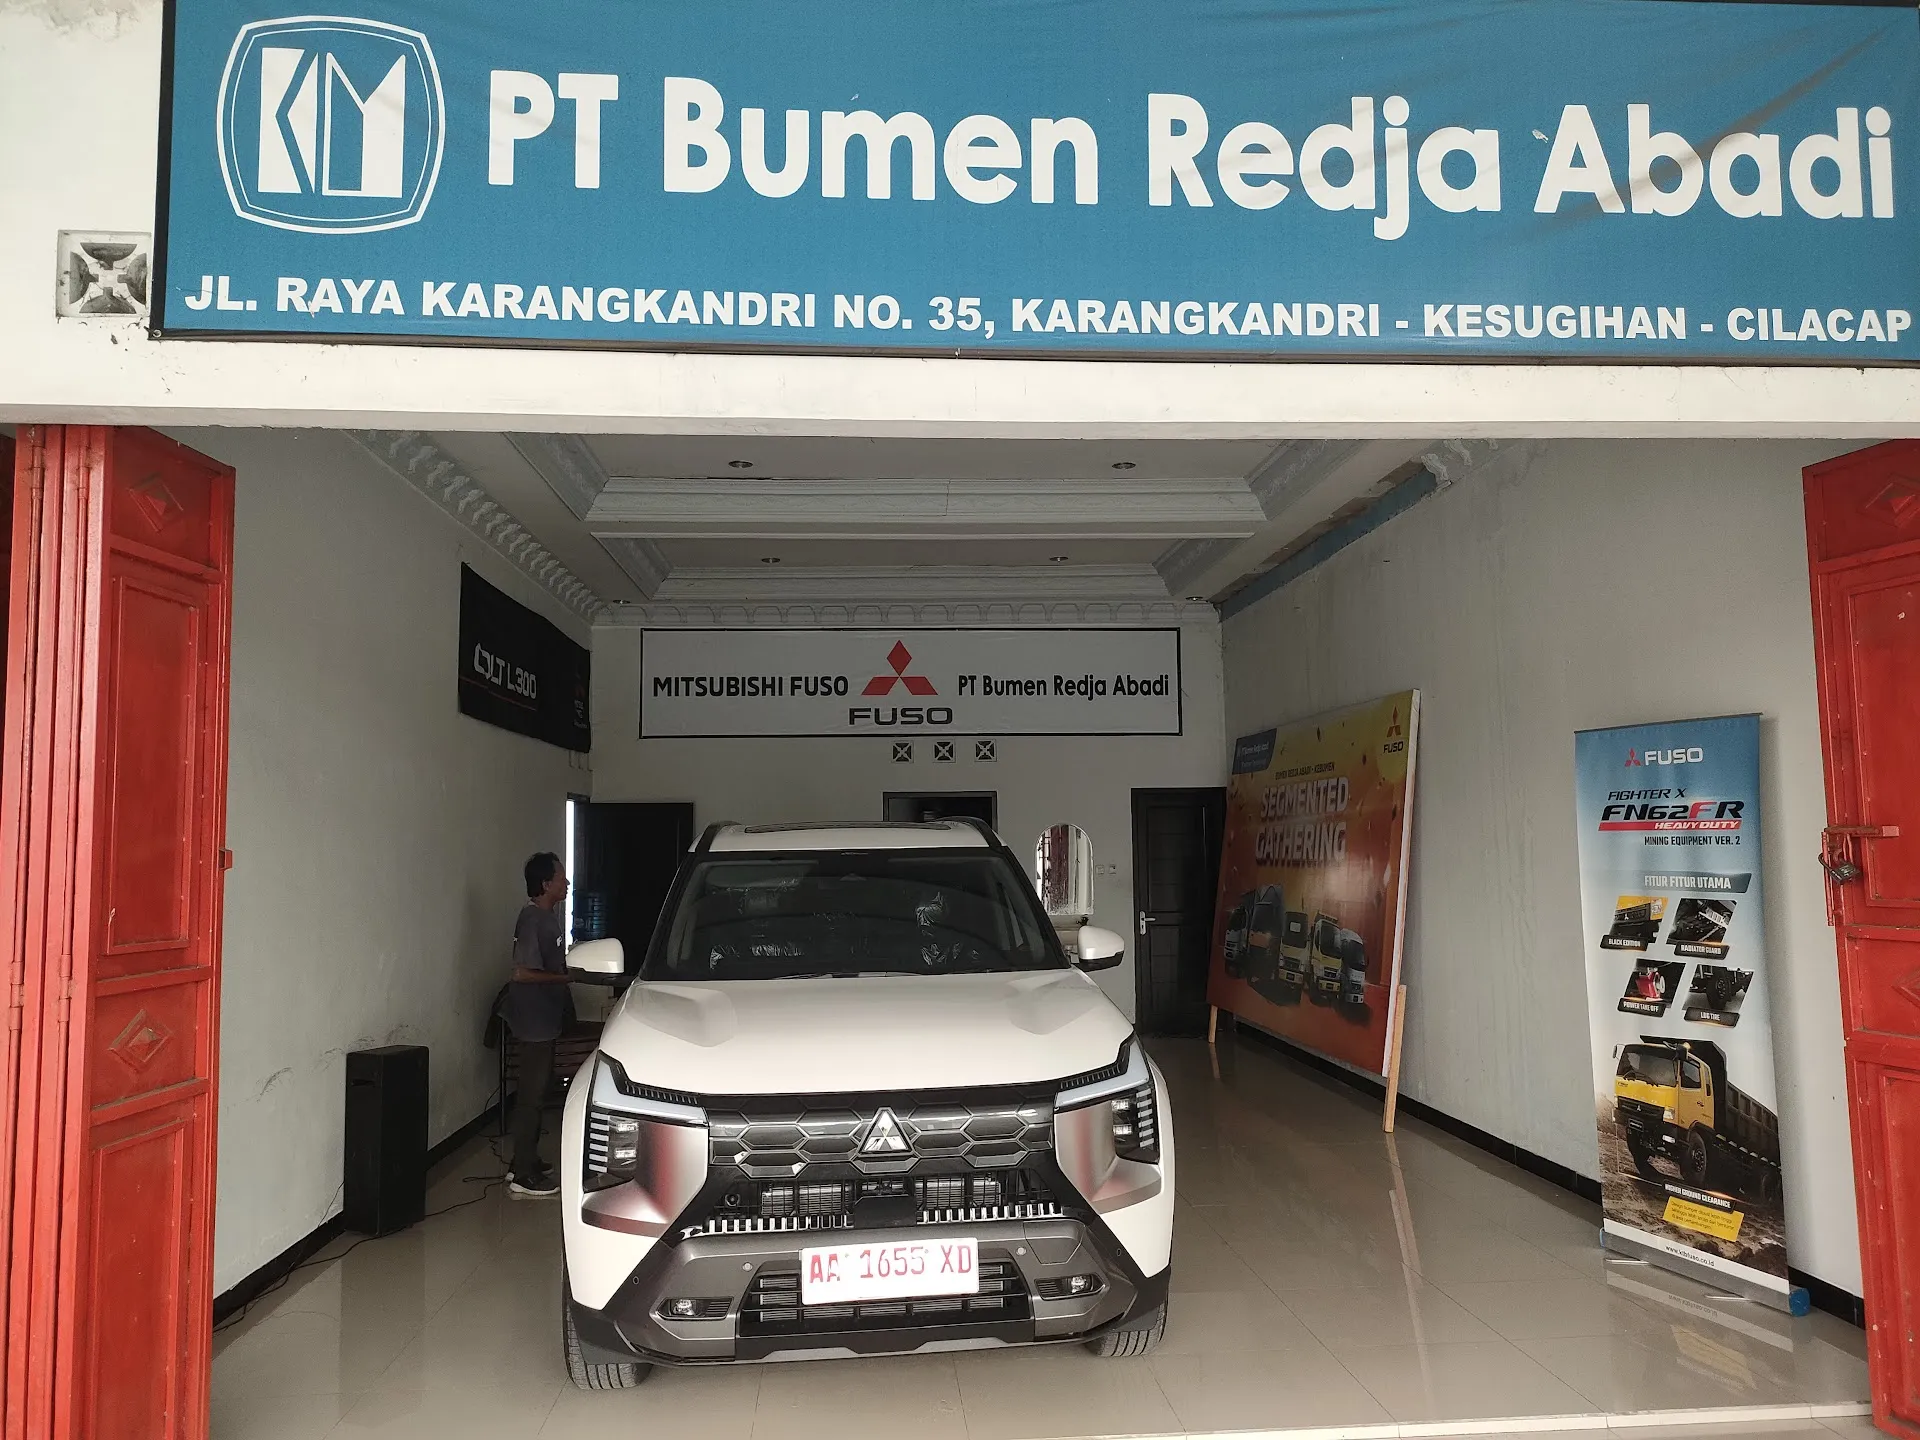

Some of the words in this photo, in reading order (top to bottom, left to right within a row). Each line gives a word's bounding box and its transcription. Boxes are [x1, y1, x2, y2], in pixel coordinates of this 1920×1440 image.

[489, 70, 619, 189] PT
[664, 77, 1098, 204] Bumen
[1148, 93, 1501, 240] Redja
[1533, 104, 1894, 219] Abadi
[185, 276, 257, 312] JL.
[276, 278, 405, 315] RAYA
[422, 282, 815, 327] KARANGKANDRI
[834, 294, 912, 330] NO.
[929, 297, 995, 339] 35,
[1012, 299, 1380, 337] KARANGKANDRI
[1423, 304, 1686, 340] KESUGIHAN
[1727, 308, 1912, 342] CILACAP
[507, 663, 536, 699] L300
[653, 676, 783, 697] MITSUBISHI
[790, 676, 849, 697] FUSO
[958, 675, 977, 696] PT
[982, 675, 1047, 697] Bumen
[1053, 674, 1107, 702] Redja
[1112, 674, 1169, 696] Abadi
[849, 707, 953, 726] FUSO
[1383, 741, 1404, 753] FUSO
[1644, 747, 1704, 766] FUSO
[1261, 777, 1349, 818] SEGMENTED
[1608, 788, 1672, 801] FIGHTER
[1675, 787, 1687, 799] X
[1601, 801, 1745, 821] FN62FR
[1654, 821, 1700, 830] HEAVY
[1699, 821, 1739, 829] DUTY
[1255, 822, 1347, 862] GATHERING
[1644, 835, 1669, 846] MINING
[1671, 835, 1712, 846] EQUIPMENT
[1715, 835, 1734, 846] VER.
[1735, 835, 1741, 845] 2
[1644, 875, 1668, 888] FITUR
[1669, 875, 1696, 888] FITUR
[1697, 876, 1732, 889] UTAMA
[1608, 938, 1623, 946] BLACK
[1680, 944, 1705, 953] RADIATOR
[1705, 946, 1722, 955] GUARD
[1623, 1001, 1639, 1010] POWER
[1639, 1003, 1650, 1011] TAKE
[1650, 1005, 1659, 1013] OFF
[1701, 1194, 1731, 1209] CLEARANCE
[809, 1253, 841, 1283] AA
[860, 1246, 925, 1279] 1655
[940, 1245, 972, 1274] XD
